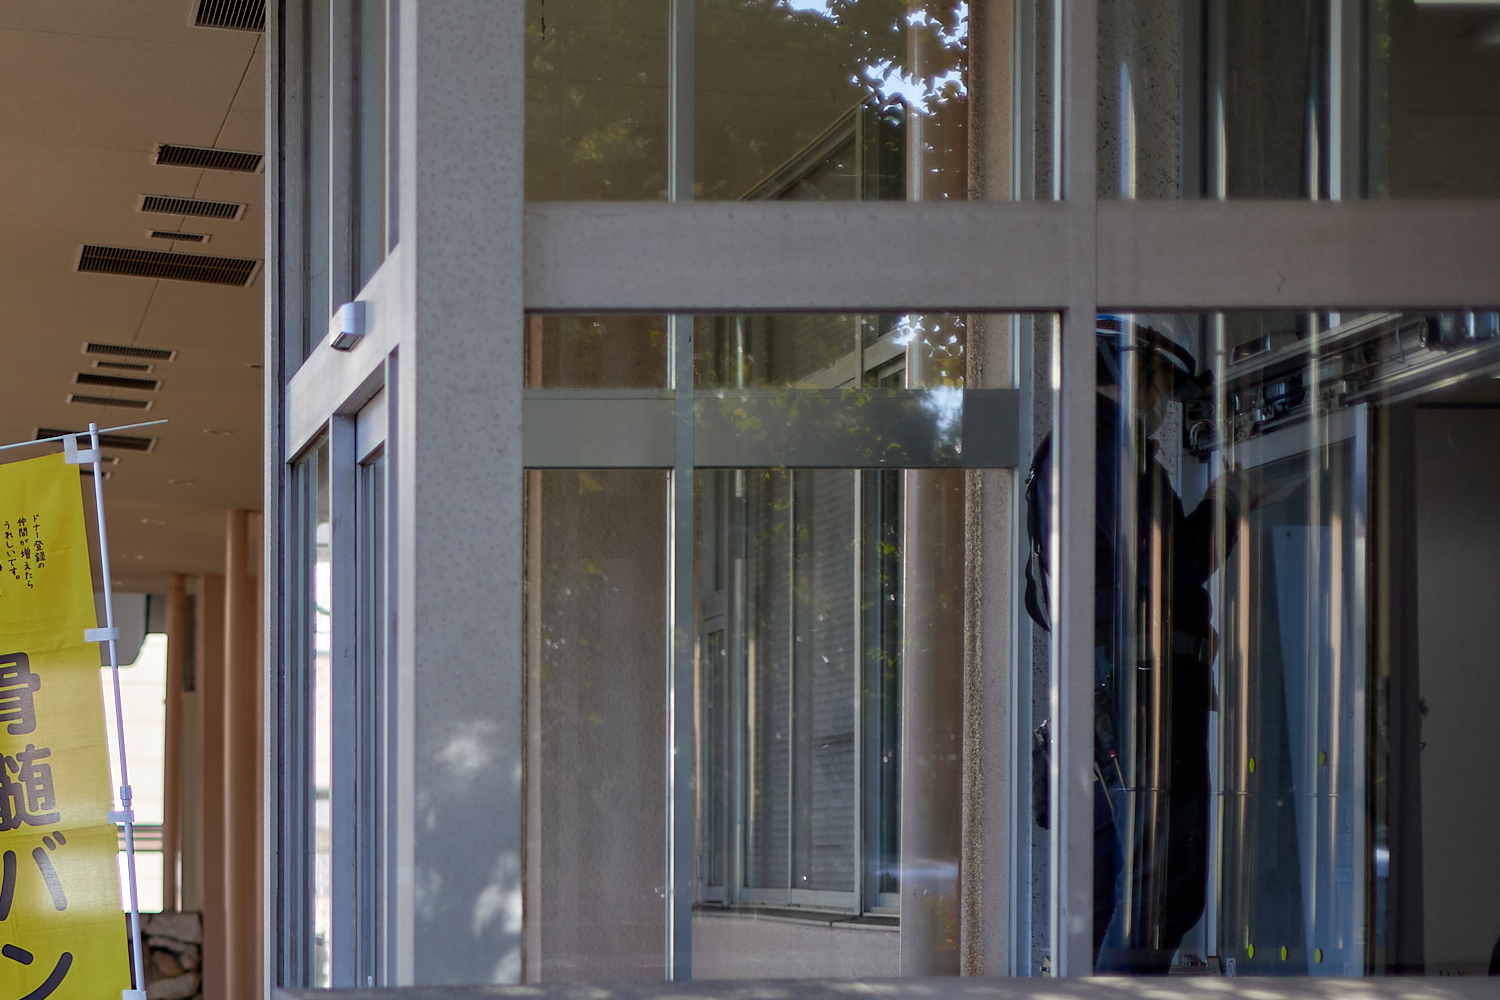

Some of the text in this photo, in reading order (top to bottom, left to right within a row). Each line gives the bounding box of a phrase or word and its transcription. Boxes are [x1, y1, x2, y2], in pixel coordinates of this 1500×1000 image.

[3, 520, 21, 580] うれしいです。
[17, 516, 34, 589] 仲間が増えたら
[32, 513, 47, 569] ドナー登録の
